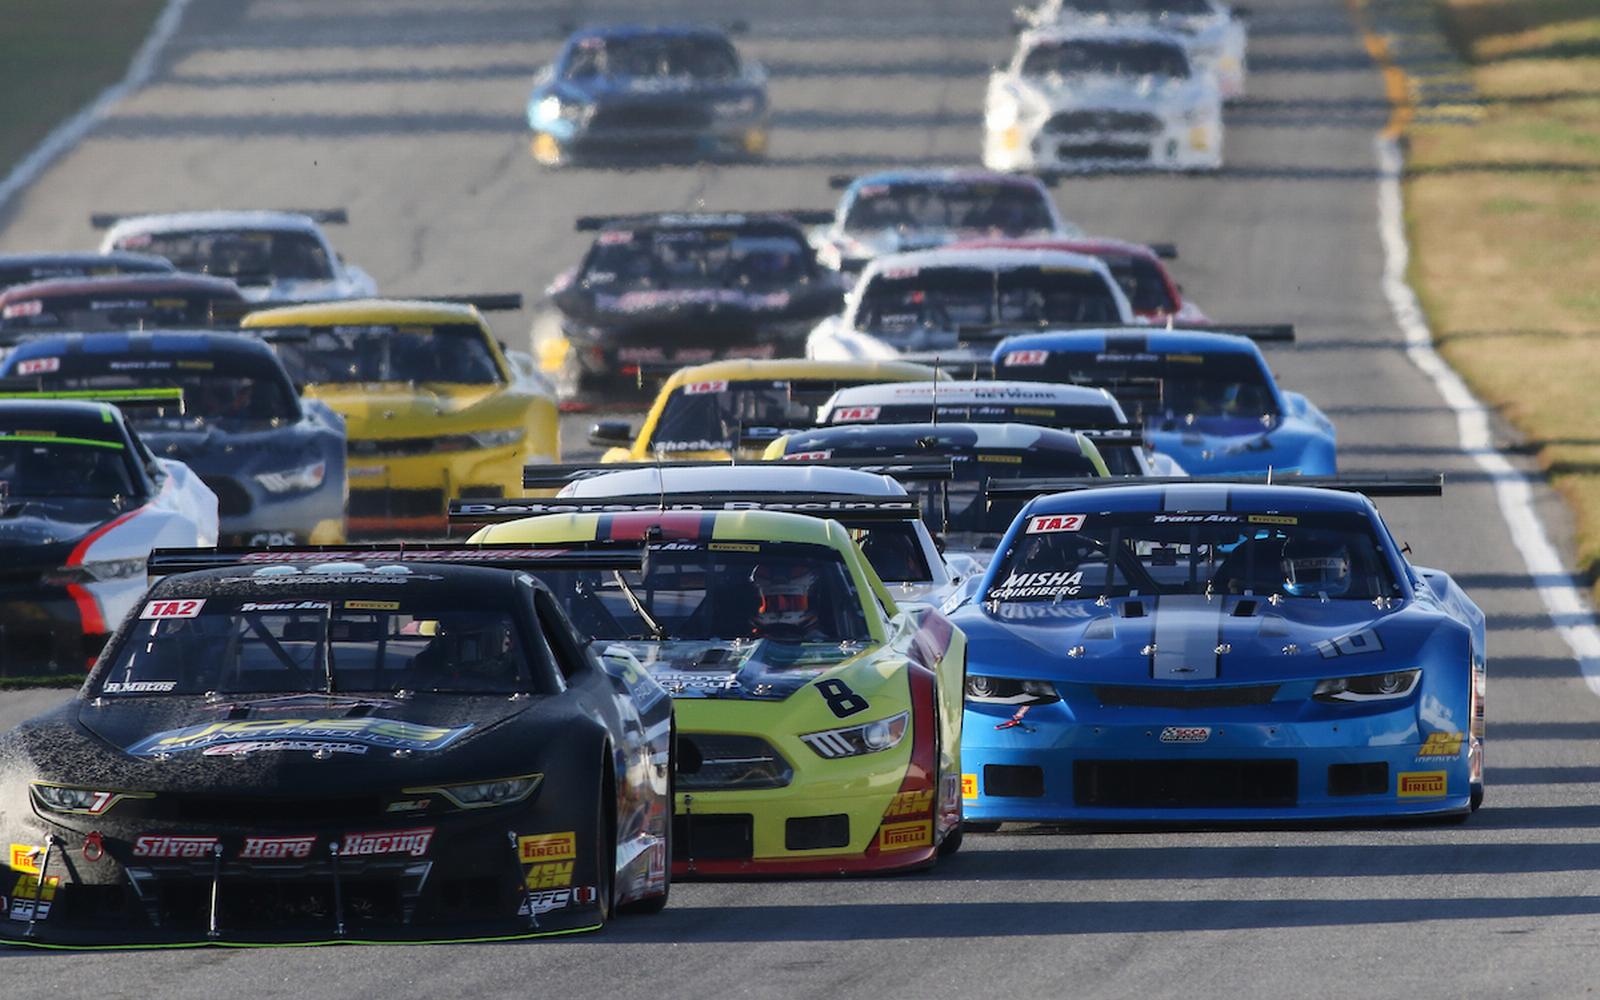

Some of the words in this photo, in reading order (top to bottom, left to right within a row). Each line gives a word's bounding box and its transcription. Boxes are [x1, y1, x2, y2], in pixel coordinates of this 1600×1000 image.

[1036, 515, 1079, 531] TA2
[1001, 569, 1084, 589] MISHA
[151, 601, 197, 616] TA2
[813, 678, 871, 719] 8
[1401, 775, 1444, 793] PIRELLI
[89, 790, 112, 813] 7
[132, 834, 218, 858] Silver
[238, 834, 318, 858] Hare
[338, 826, 437, 857] Racing
[884, 824, 928, 845] PIRELLI
[524, 837, 571, 858] PIRELLI
